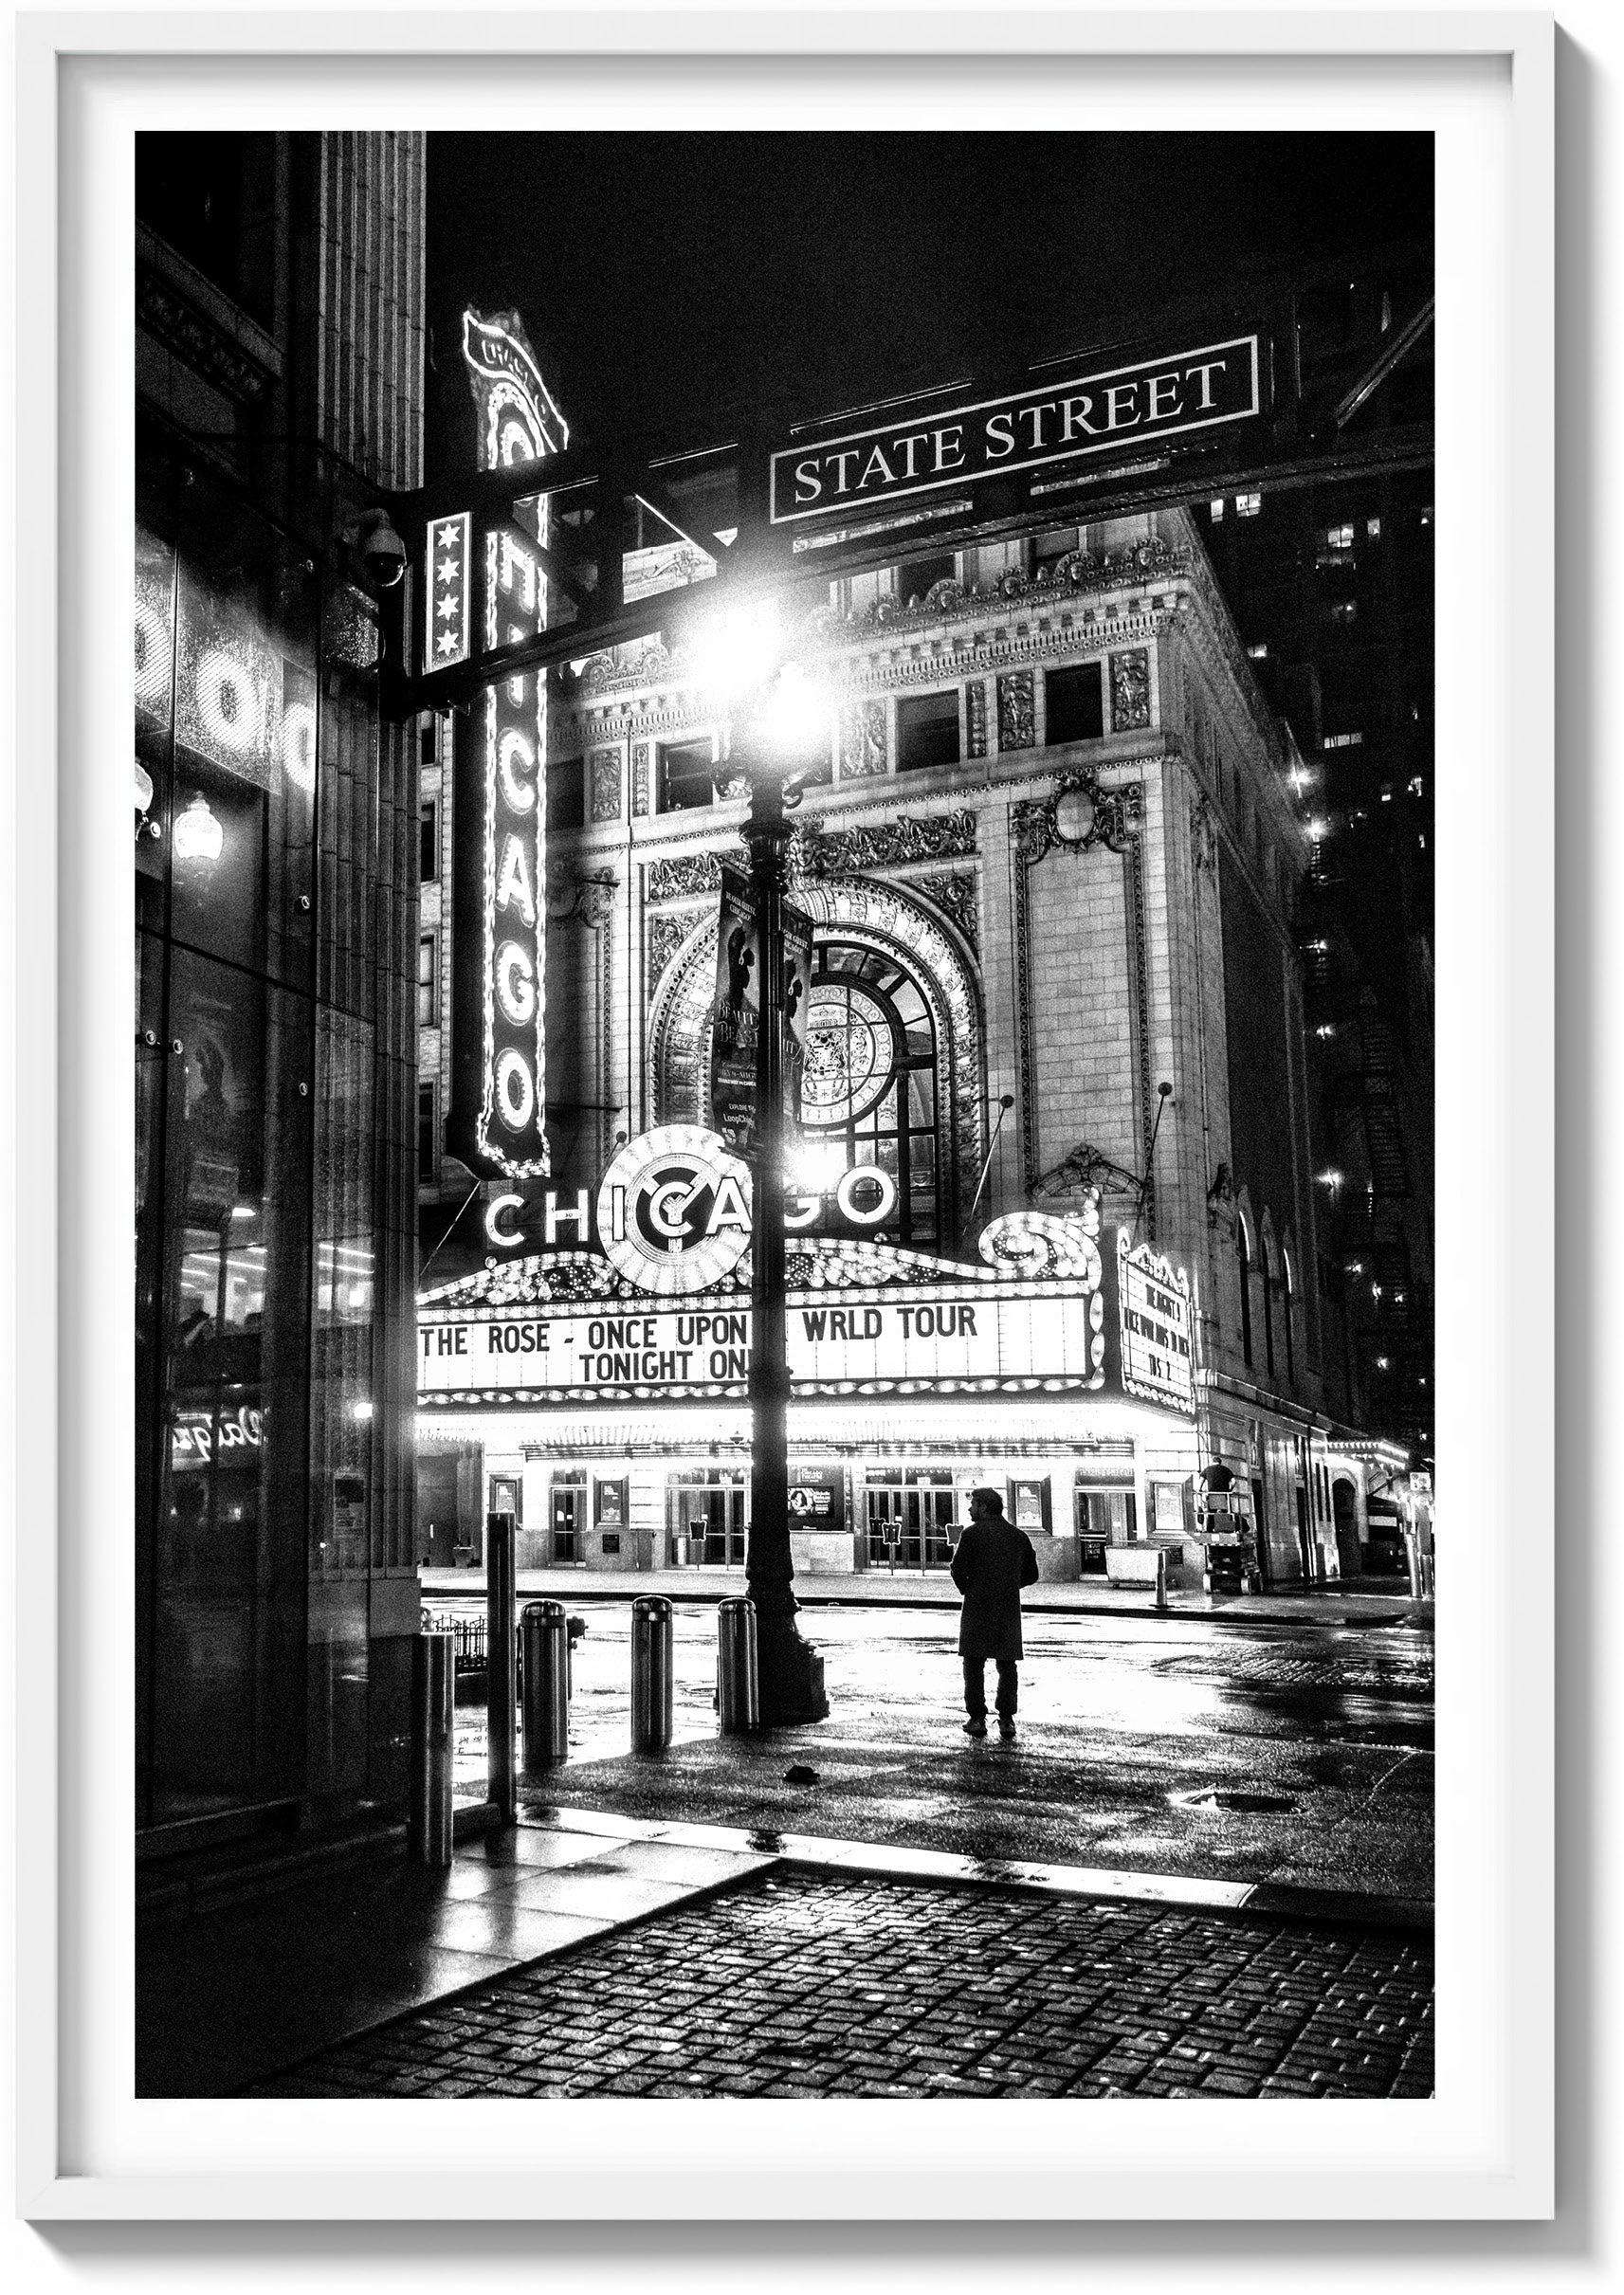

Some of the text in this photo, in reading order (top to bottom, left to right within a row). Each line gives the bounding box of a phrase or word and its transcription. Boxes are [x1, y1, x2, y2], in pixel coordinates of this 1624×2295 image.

[794, 360, 1227, 503] STATE STREET
[485, 1165, 897, 1247] CHICAGO
[420, 1327, 468, 1357] THE
[488, 1323, 550, 1354] ROSE
[589, 1318, 658, 1350] ONCE
[678, 1314, 748, 1346] UPON
[802, 1308, 883, 1341] WRLD
[896, 1304, 977, 1339] TOUR
[578, 1351, 693, 1382] TONIGHT
